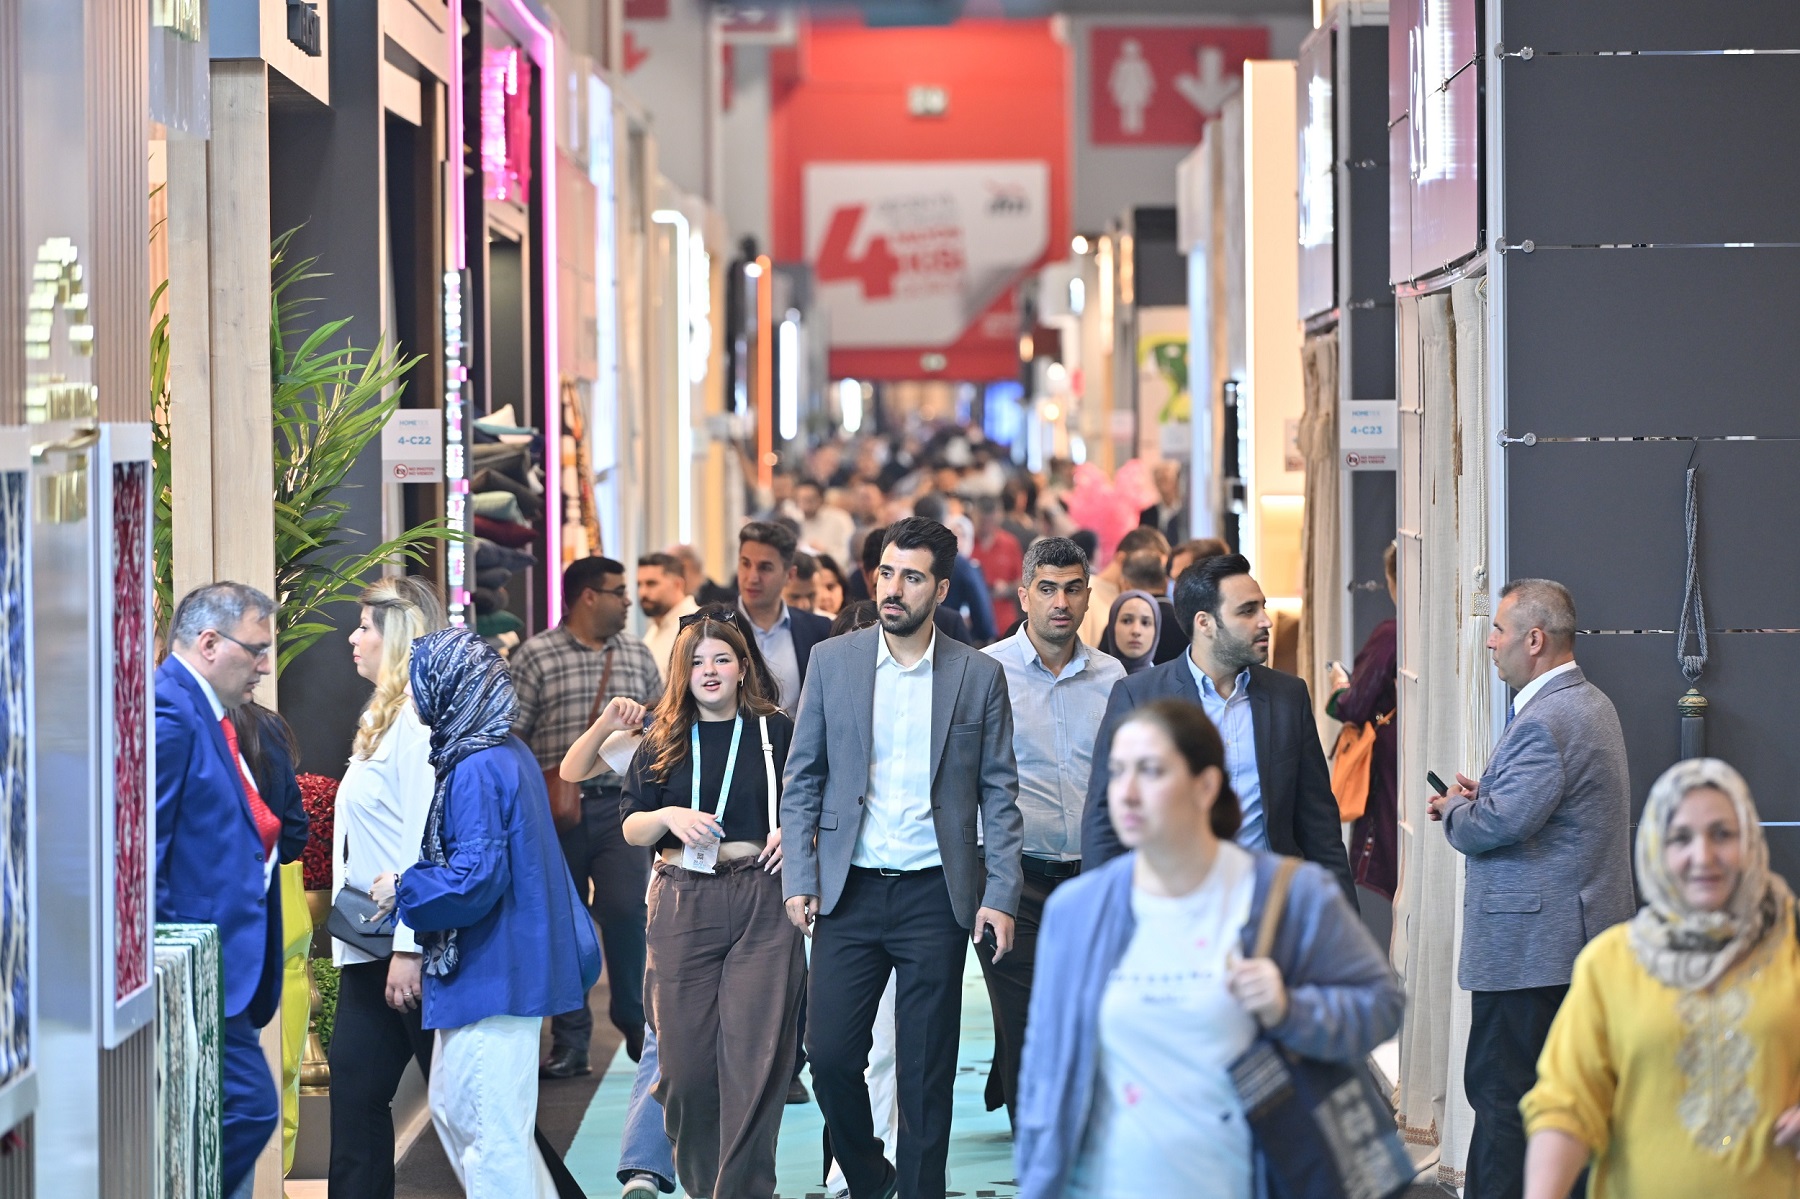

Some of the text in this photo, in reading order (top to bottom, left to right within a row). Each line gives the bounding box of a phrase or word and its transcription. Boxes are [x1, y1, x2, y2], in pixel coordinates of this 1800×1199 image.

[816, 203, 899, 302] 4
[1351, 426, 1383, 435] 4-C23
[398, 436, 432, 445] 4-C22
